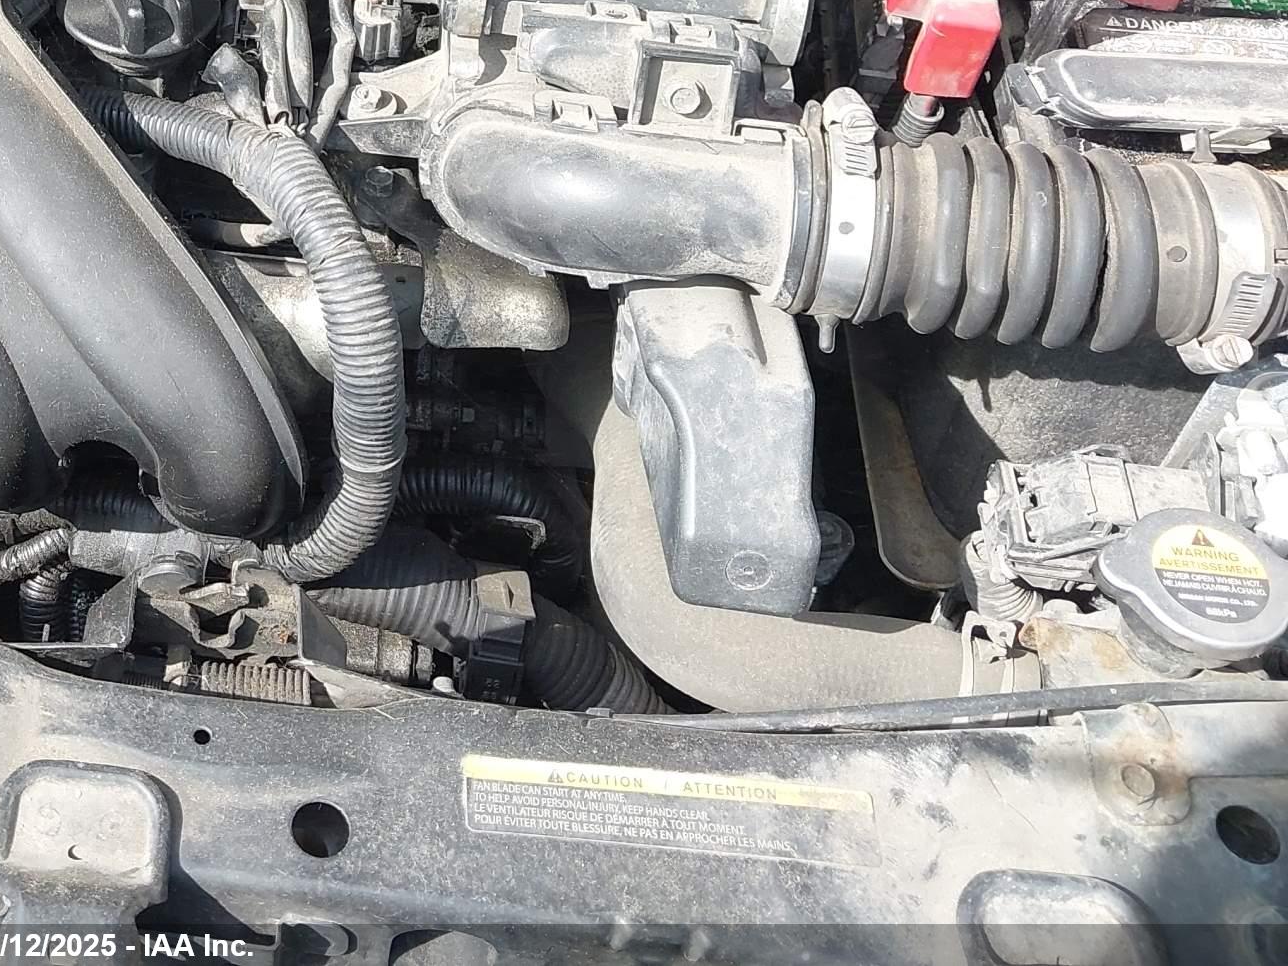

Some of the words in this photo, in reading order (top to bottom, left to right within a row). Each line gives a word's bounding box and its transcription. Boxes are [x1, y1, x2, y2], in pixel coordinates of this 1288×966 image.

[1125, 18, 1204, 33] DANGER
[1171, 547, 1240, 561] WARNING
[1159, 558, 1259, 575] AVERTISSEMENT
[1162, 571, 1190, 580] NEVER
[1191, 573, 1214, 582] OPEN
[473, 781, 491, 791] FAN
[491, 783, 521, 794] BLADE
[522, 785, 542, 795] CAN
[543, 787, 569, 797] START
[571, 789, 582, 798] AT
[584, 790, 602, 800] ANY
[566, 771, 643, 788] CAUTION
[683, 781, 777, 800] ATTENTION
[474, 792, 486, 802] TO
[488, 794, 509, 804] HELP
[512, 795, 540, 806] AVOID
[541, 797, 588, 810] PERSONAL
[622, 804, 644, 815] KEEP
[646, 806, 680, 819] HANDS
[474, 803, 486, 812] LE
[487, 804, 551, 819] VENTILATEUR
[553, 810, 585, 821] RISQUE
[589, 813, 603, 822] DE
[670, 819, 696, 831] TOUT
[474, 815, 502, 825] POUR
[539, 819, 570, 831] TOUTE
[625, 828, 637, 838] NE
[640, 829, 657, 839] PAS
[660, 831, 673, 840] EN
[676, 831, 736, 846] APPROCHER
[738, 838, 755, 848] LES
